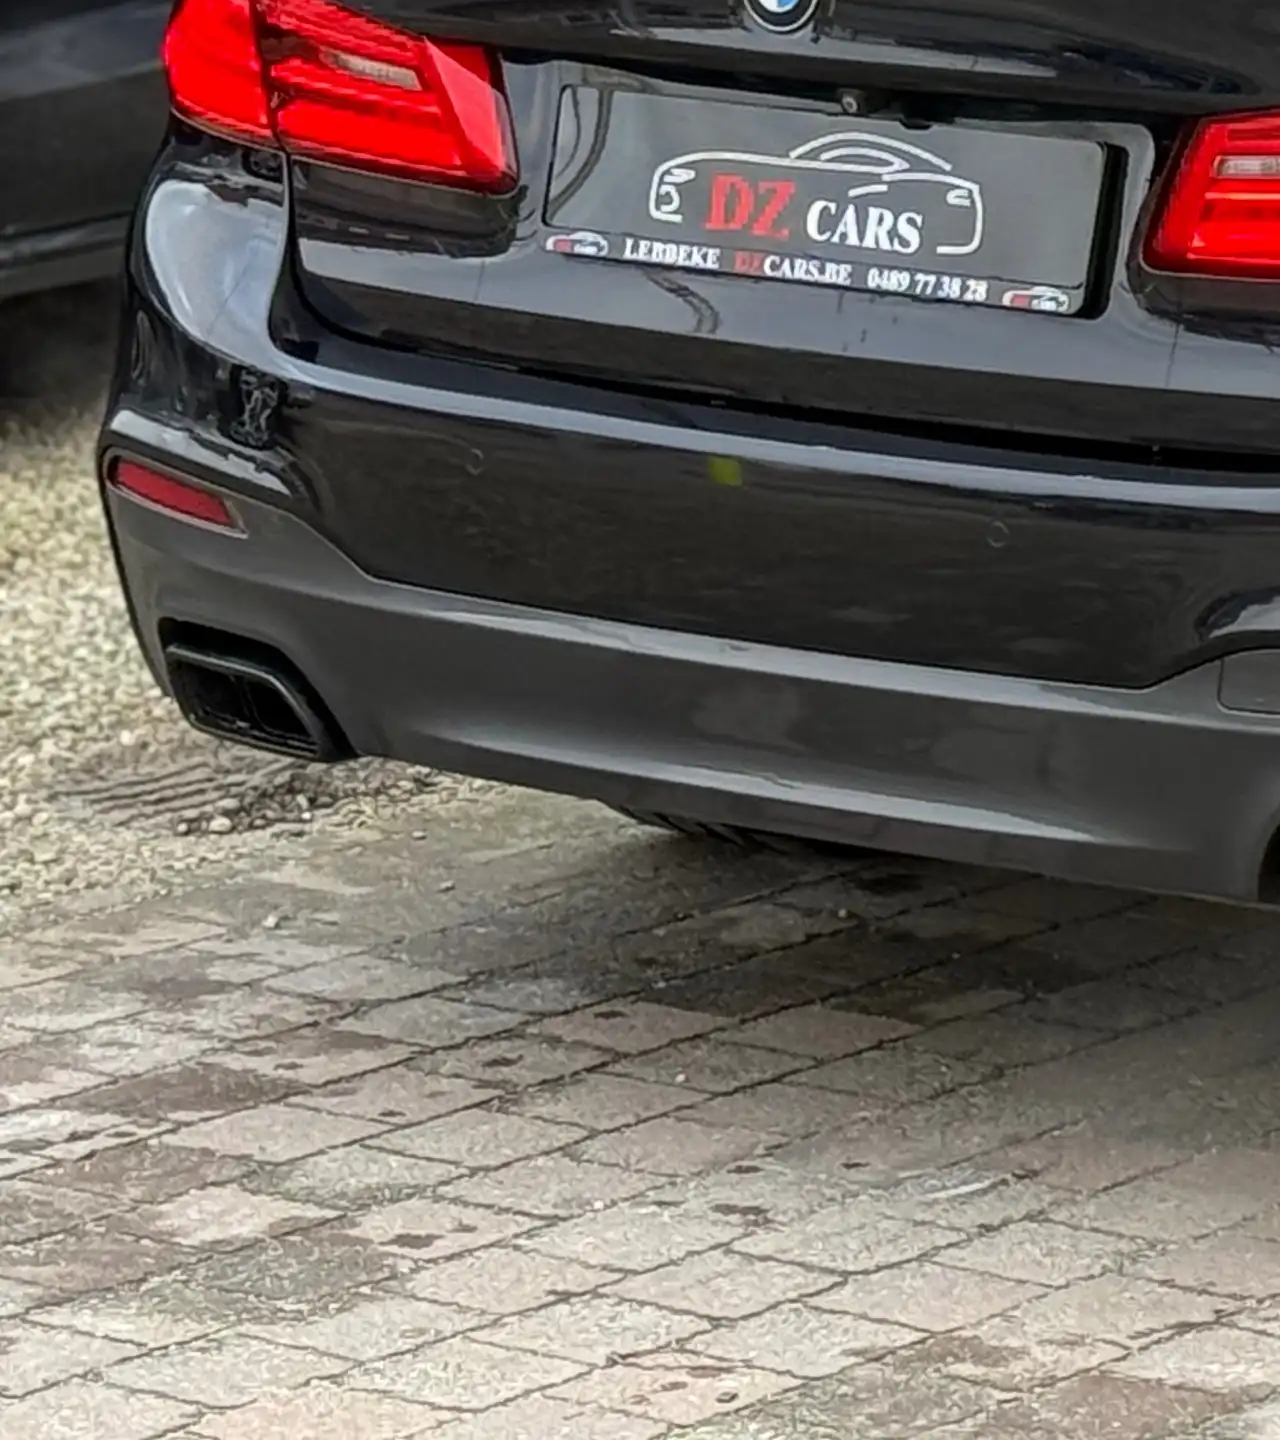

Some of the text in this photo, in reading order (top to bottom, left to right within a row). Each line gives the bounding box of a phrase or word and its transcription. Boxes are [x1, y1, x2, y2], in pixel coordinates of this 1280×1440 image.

[705, 172, 923, 254] DZ CARS
[867, 267, 910, 292] 0489
[913, 273, 937, 296] 77
[937, 275, 962, 299] 38
